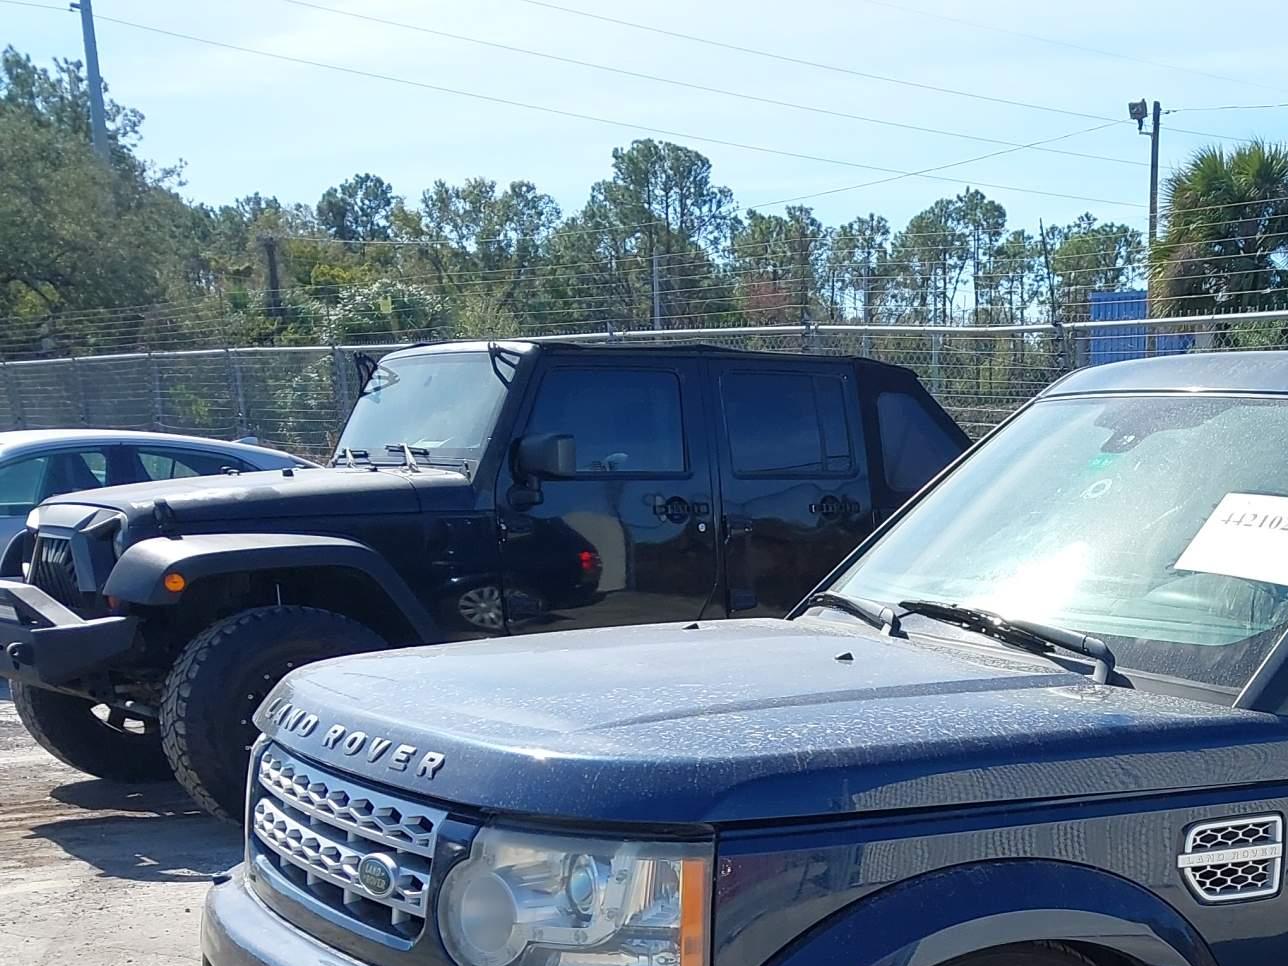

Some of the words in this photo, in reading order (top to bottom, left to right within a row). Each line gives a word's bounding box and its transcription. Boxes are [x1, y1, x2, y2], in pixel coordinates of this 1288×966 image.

[265, 697, 320, 737] LAND
[321, 724, 447, 780] ROVER
[1186, 853, 1225, 865] LAND
[1231, 846, 1278, 860] ROVER
